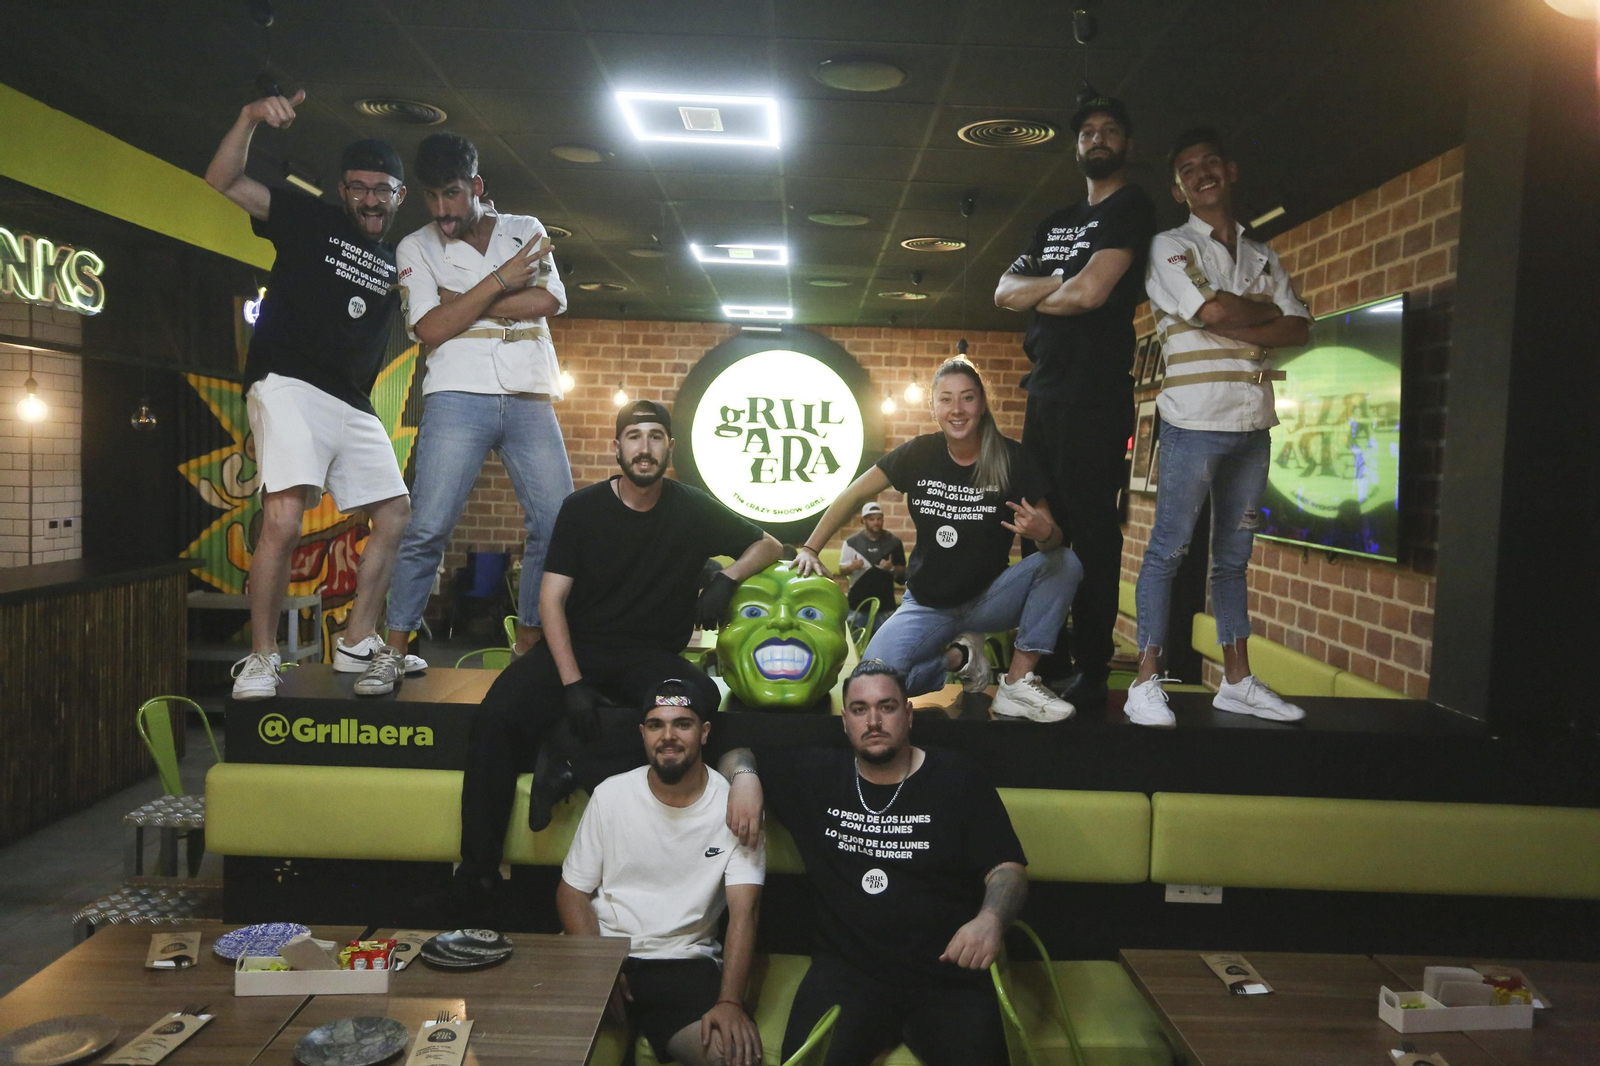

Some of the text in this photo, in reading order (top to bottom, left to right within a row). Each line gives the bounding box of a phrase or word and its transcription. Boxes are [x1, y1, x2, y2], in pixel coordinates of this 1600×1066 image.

[329, 236, 340, 245] LO
[341, 241, 362, 256] PEOR
[362, 251, 373, 261] DE
[325, 255, 335, 265] LO
[336, 260, 360, 276] MEJOR
[341, 249, 357, 262] SON
[357, 257, 372, 270] LOS
[335, 268, 387, 296] SON LAS BURGER
[927, 480, 947, 490] PEOR
[958, 486, 975, 494] LOS
[927, 488, 944, 497] SON
[920, 499, 945, 510] MEJOR
[946, 505, 958, 513] DE
[972, 505, 997, 513] LUNES
[920, 507, 936, 515] SON
[936, 510, 953, 520] LAS
[258, 712, 434, 746] @Grillaera
[827, 807, 931, 824] LO PEOR DE LOS LUNES
[840, 820, 913, 834] SON LOS LUNES
[825, 828, 837, 837] LO
[865, 839, 878, 848] DE
[880, 840, 898, 849] LOS
[900, 841, 930, 850] LUNES
[838, 841, 913, 859] SON LAS BURGER
